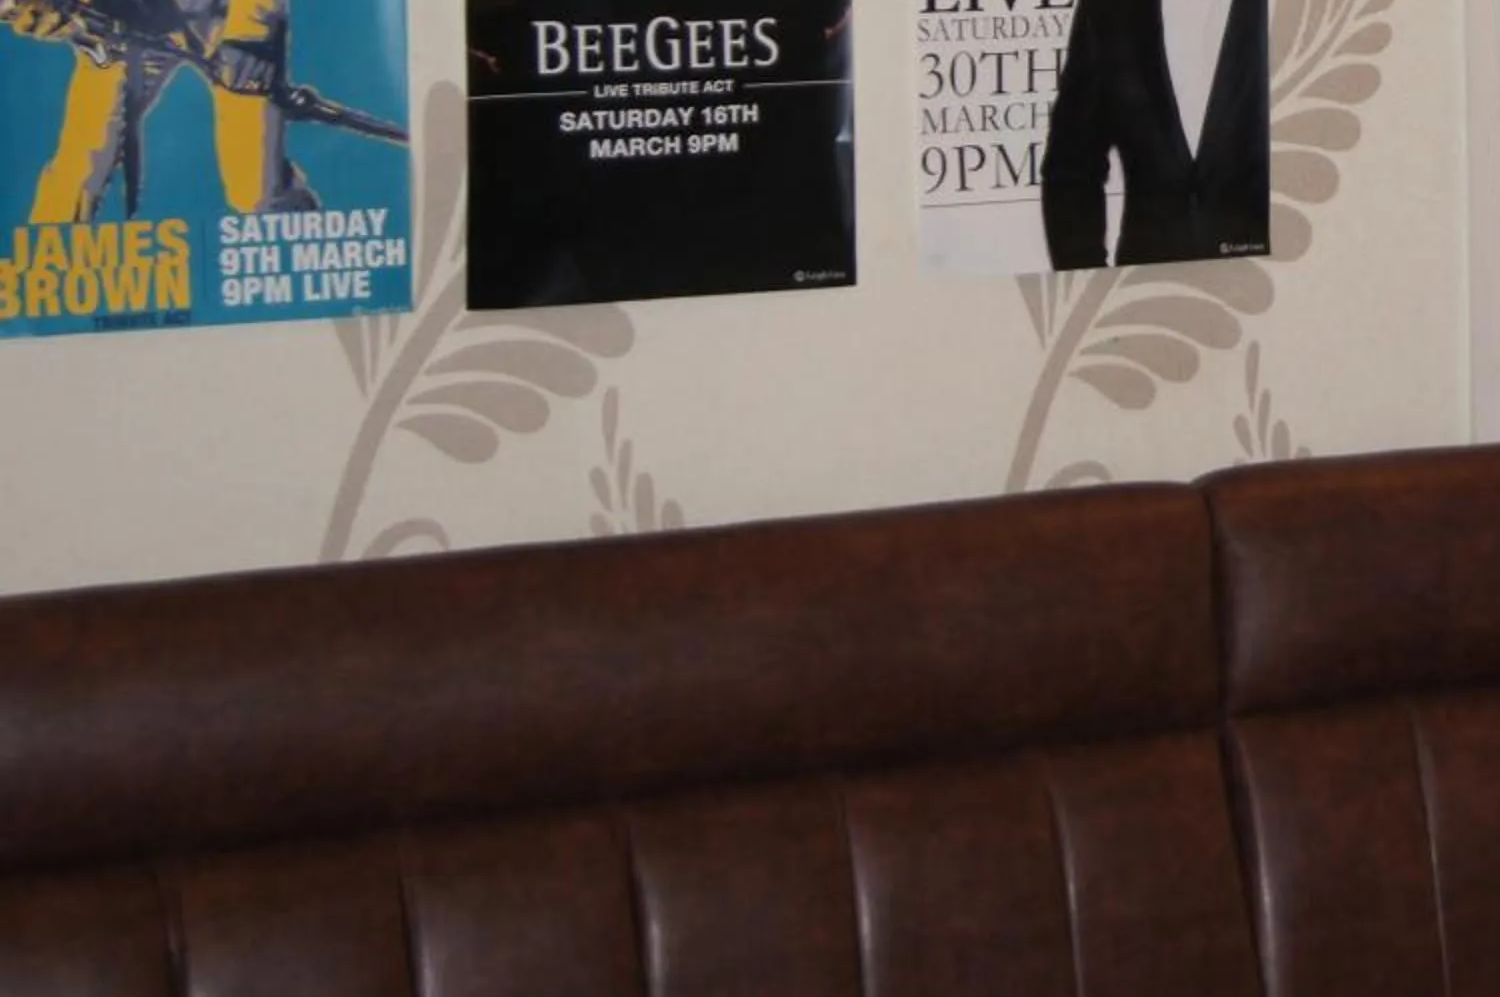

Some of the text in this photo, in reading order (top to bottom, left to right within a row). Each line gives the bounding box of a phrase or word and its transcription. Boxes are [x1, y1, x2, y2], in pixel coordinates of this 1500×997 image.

[916, 12, 1071, 43] SATURDAY
[593, 79, 735, 98] LIVE TRIBUTE ACT
[918, 48, 1067, 99] 30TH
[559, 104, 760, 132] SATURDAY 16TH
[920, 101, 1052, 135] MARCH
[589, 133, 740, 159] MARCH 9PM
[920, 141, 1042, 194] 9PM
[14, 218, 190, 272] JAMES
[218, 208, 389, 245] SATURDAY
[219, 238, 407, 276] 9TH MARCH
[0, 251, 191, 320] BROWN
[222, 270, 372, 307] 9PM LIVE
